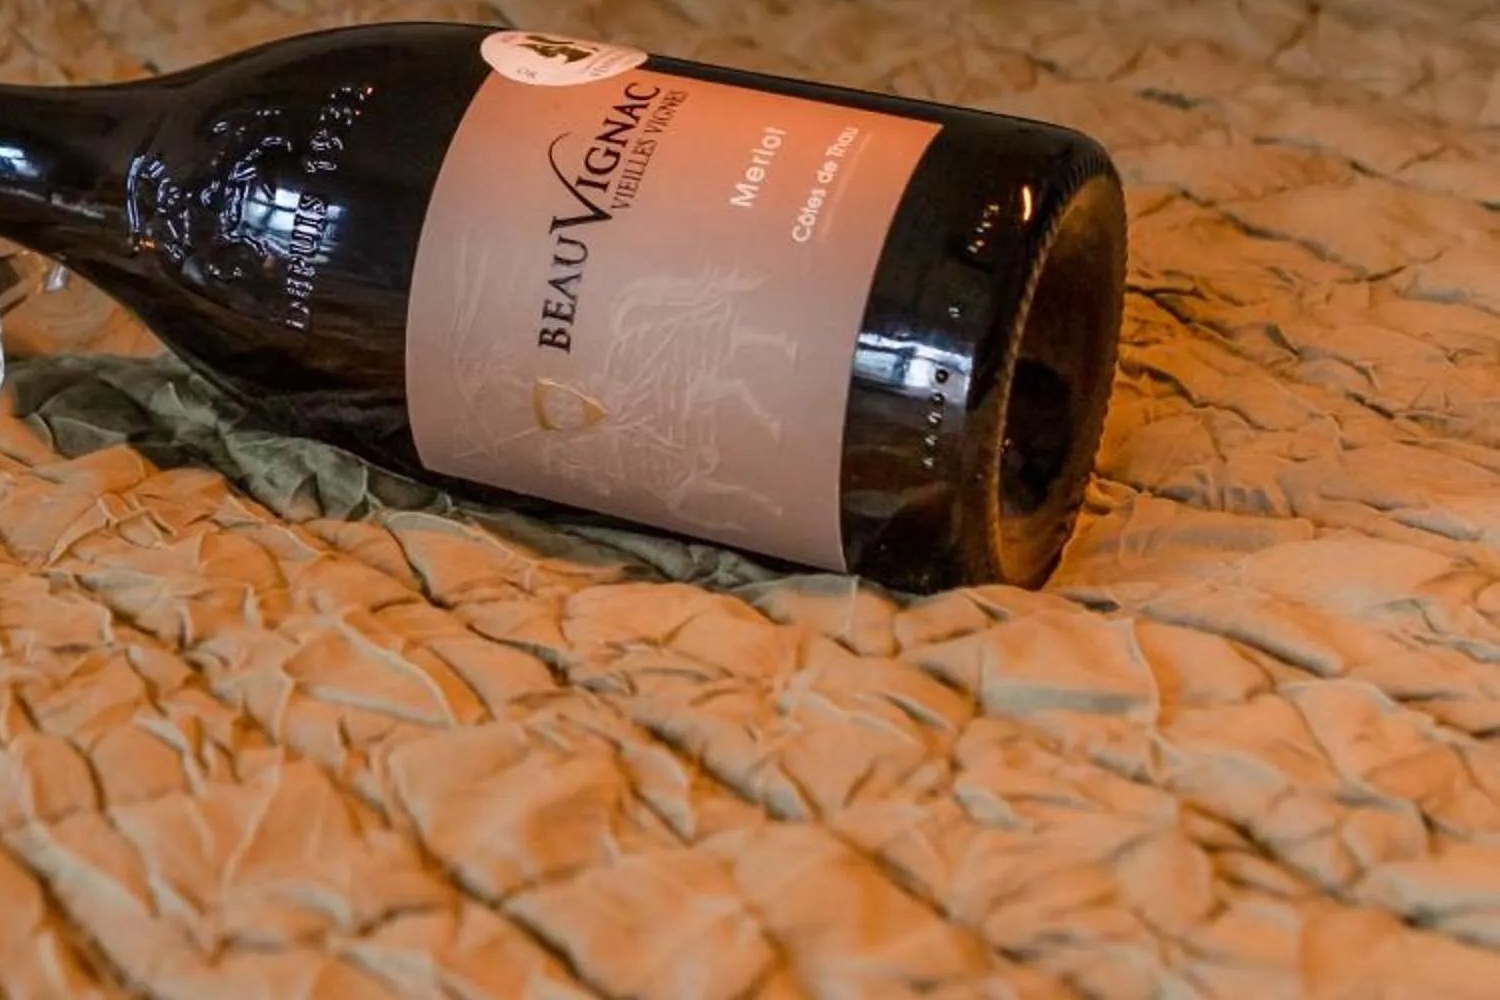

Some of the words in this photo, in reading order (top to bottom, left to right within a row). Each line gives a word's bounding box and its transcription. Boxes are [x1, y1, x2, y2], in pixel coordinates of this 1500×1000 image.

[611, 138, 658, 209] VIEILLES
[643, 89, 689, 134] VIGNES
[729, 126, 788, 208] Merlot
[825, 126, 859, 158] Thau
[816, 160, 838, 184] de
[791, 187, 828, 242] Côtes
